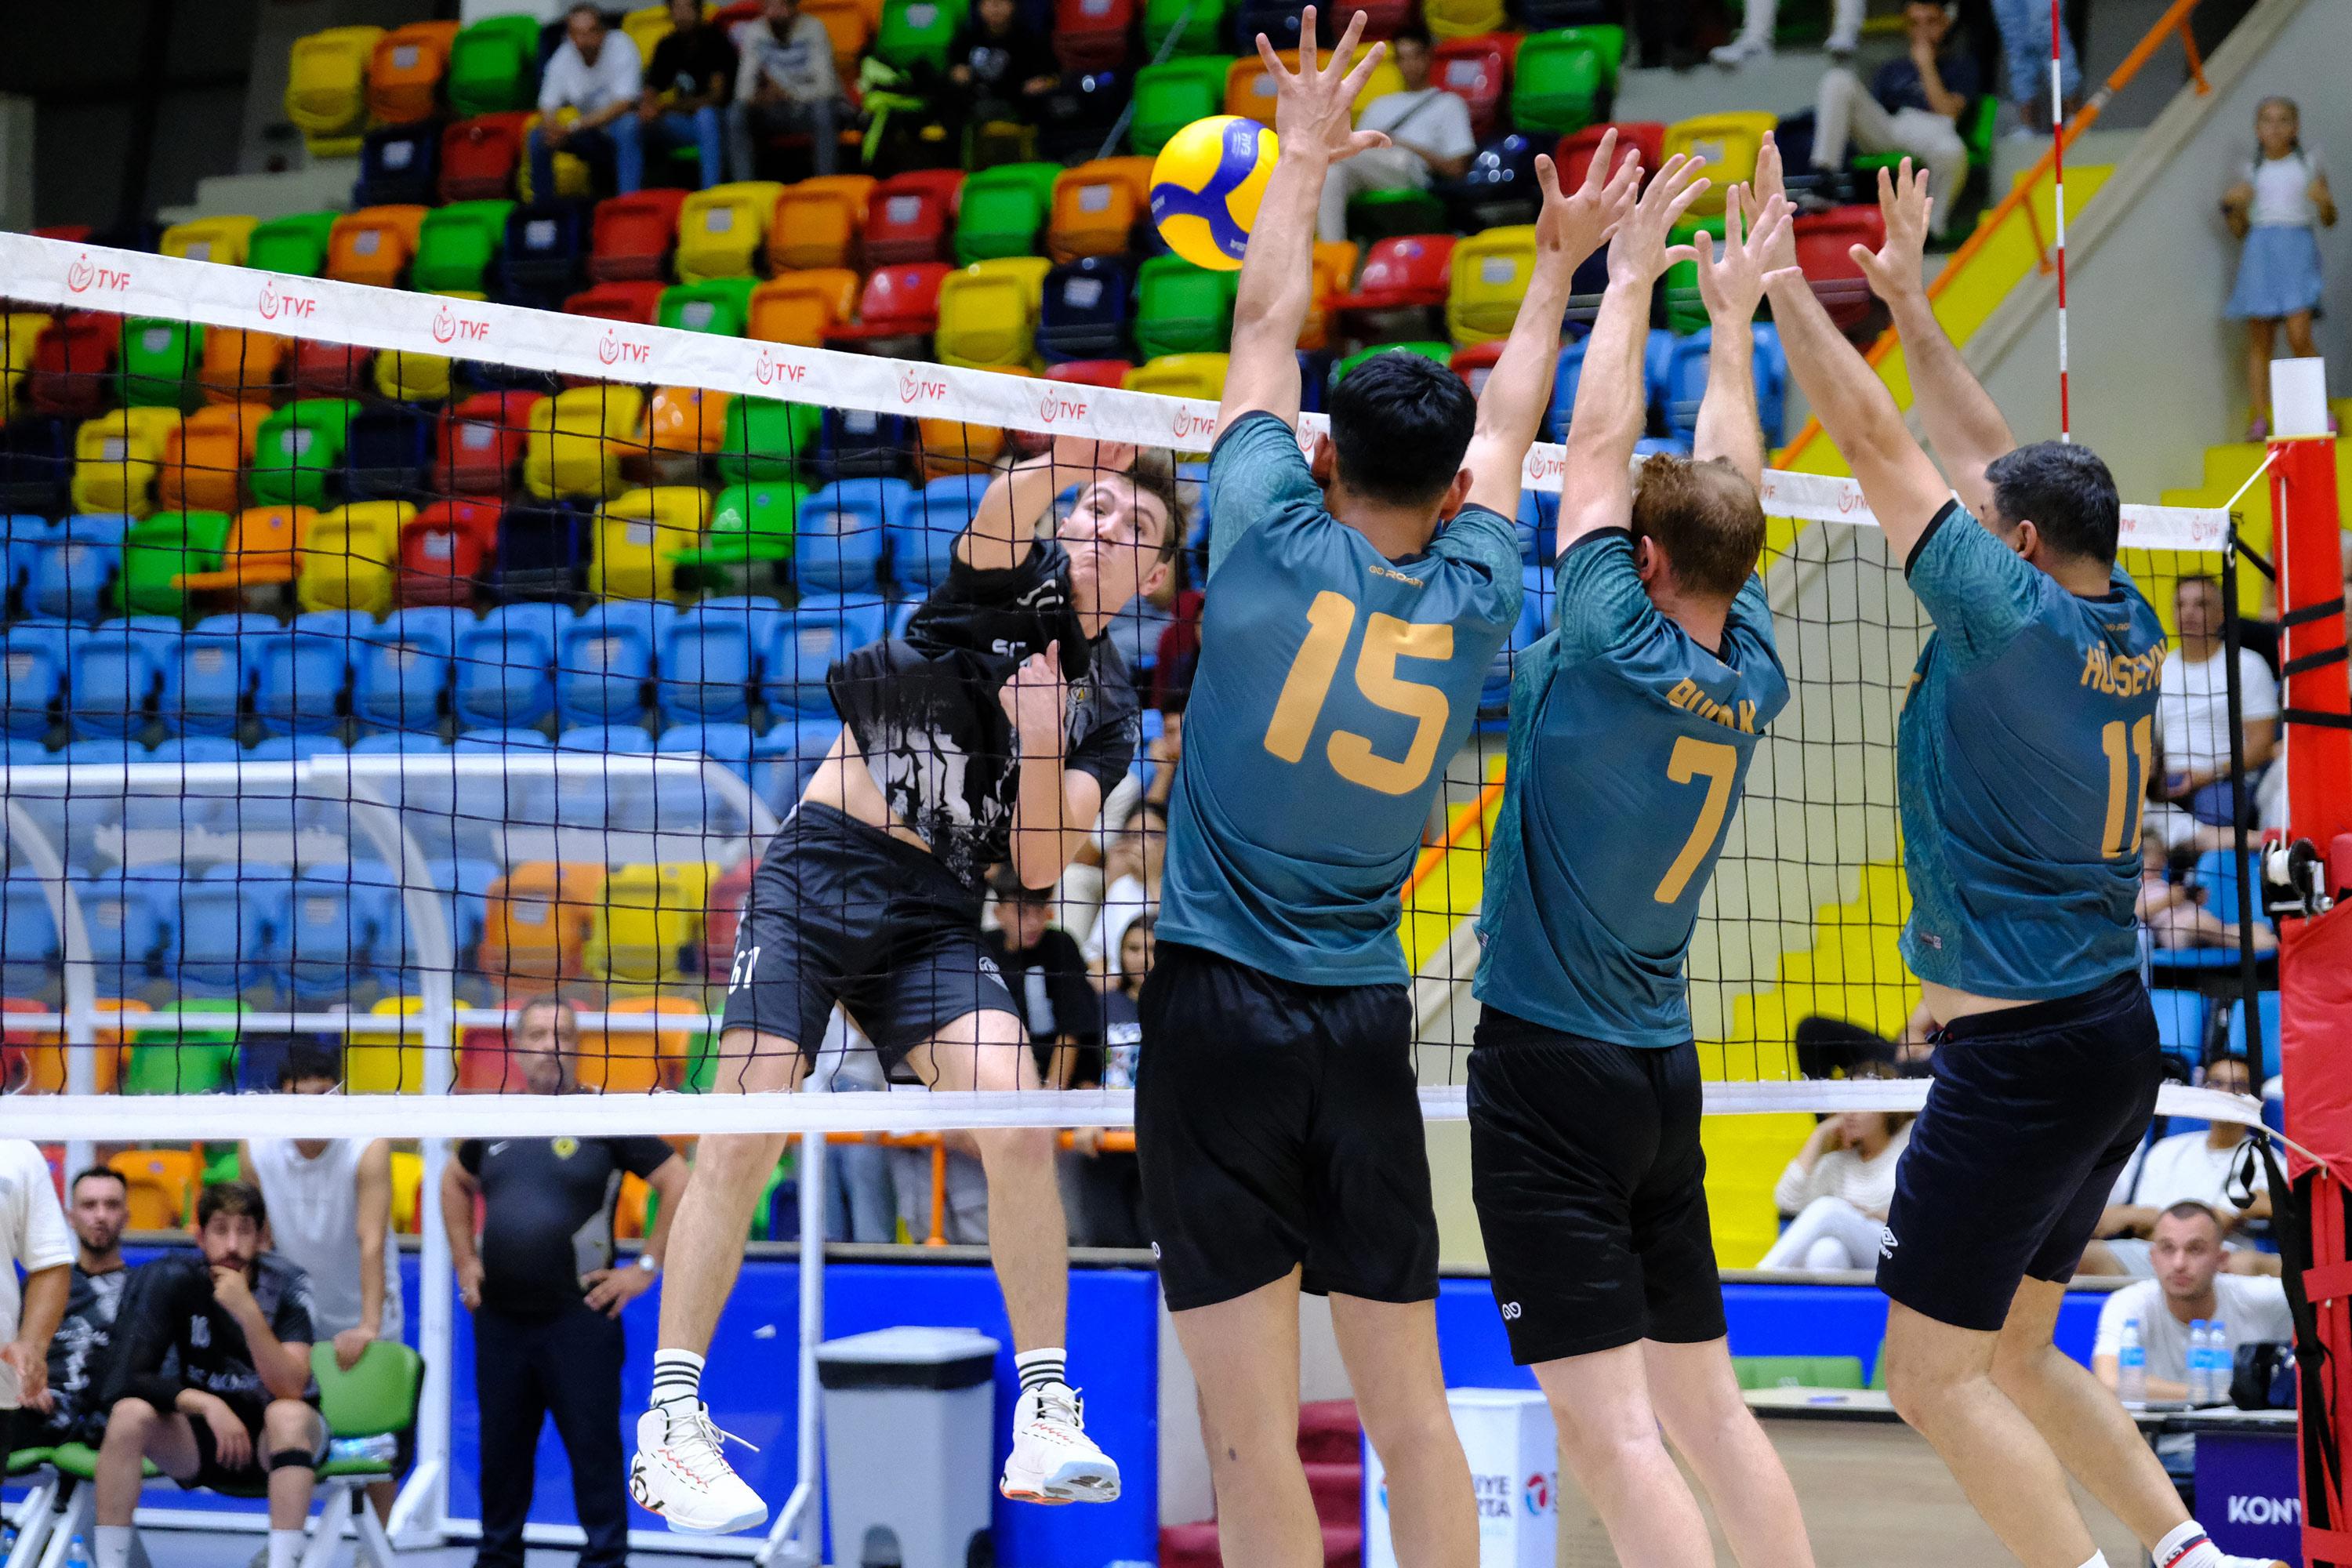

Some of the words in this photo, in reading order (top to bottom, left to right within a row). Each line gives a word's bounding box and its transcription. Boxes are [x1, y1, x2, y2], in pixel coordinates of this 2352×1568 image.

[98, 269, 131, 292] TVF
[281, 296, 315, 318] TVF
[459, 320, 490, 341] TVF
[622, 343, 651, 363] TVF
[776, 364, 806, 383] TVF
[920, 382, 946, 400] TVF
[1060, 401, 1087, 420] TVF
[1192, 416, 1215, 435] TVF
[1263, 590, 1454, 796] 15
[2101, 714, 2152, 858] 11
[1653, 735, 1737, 903] 7
[728, 946, 761, 996] 61
